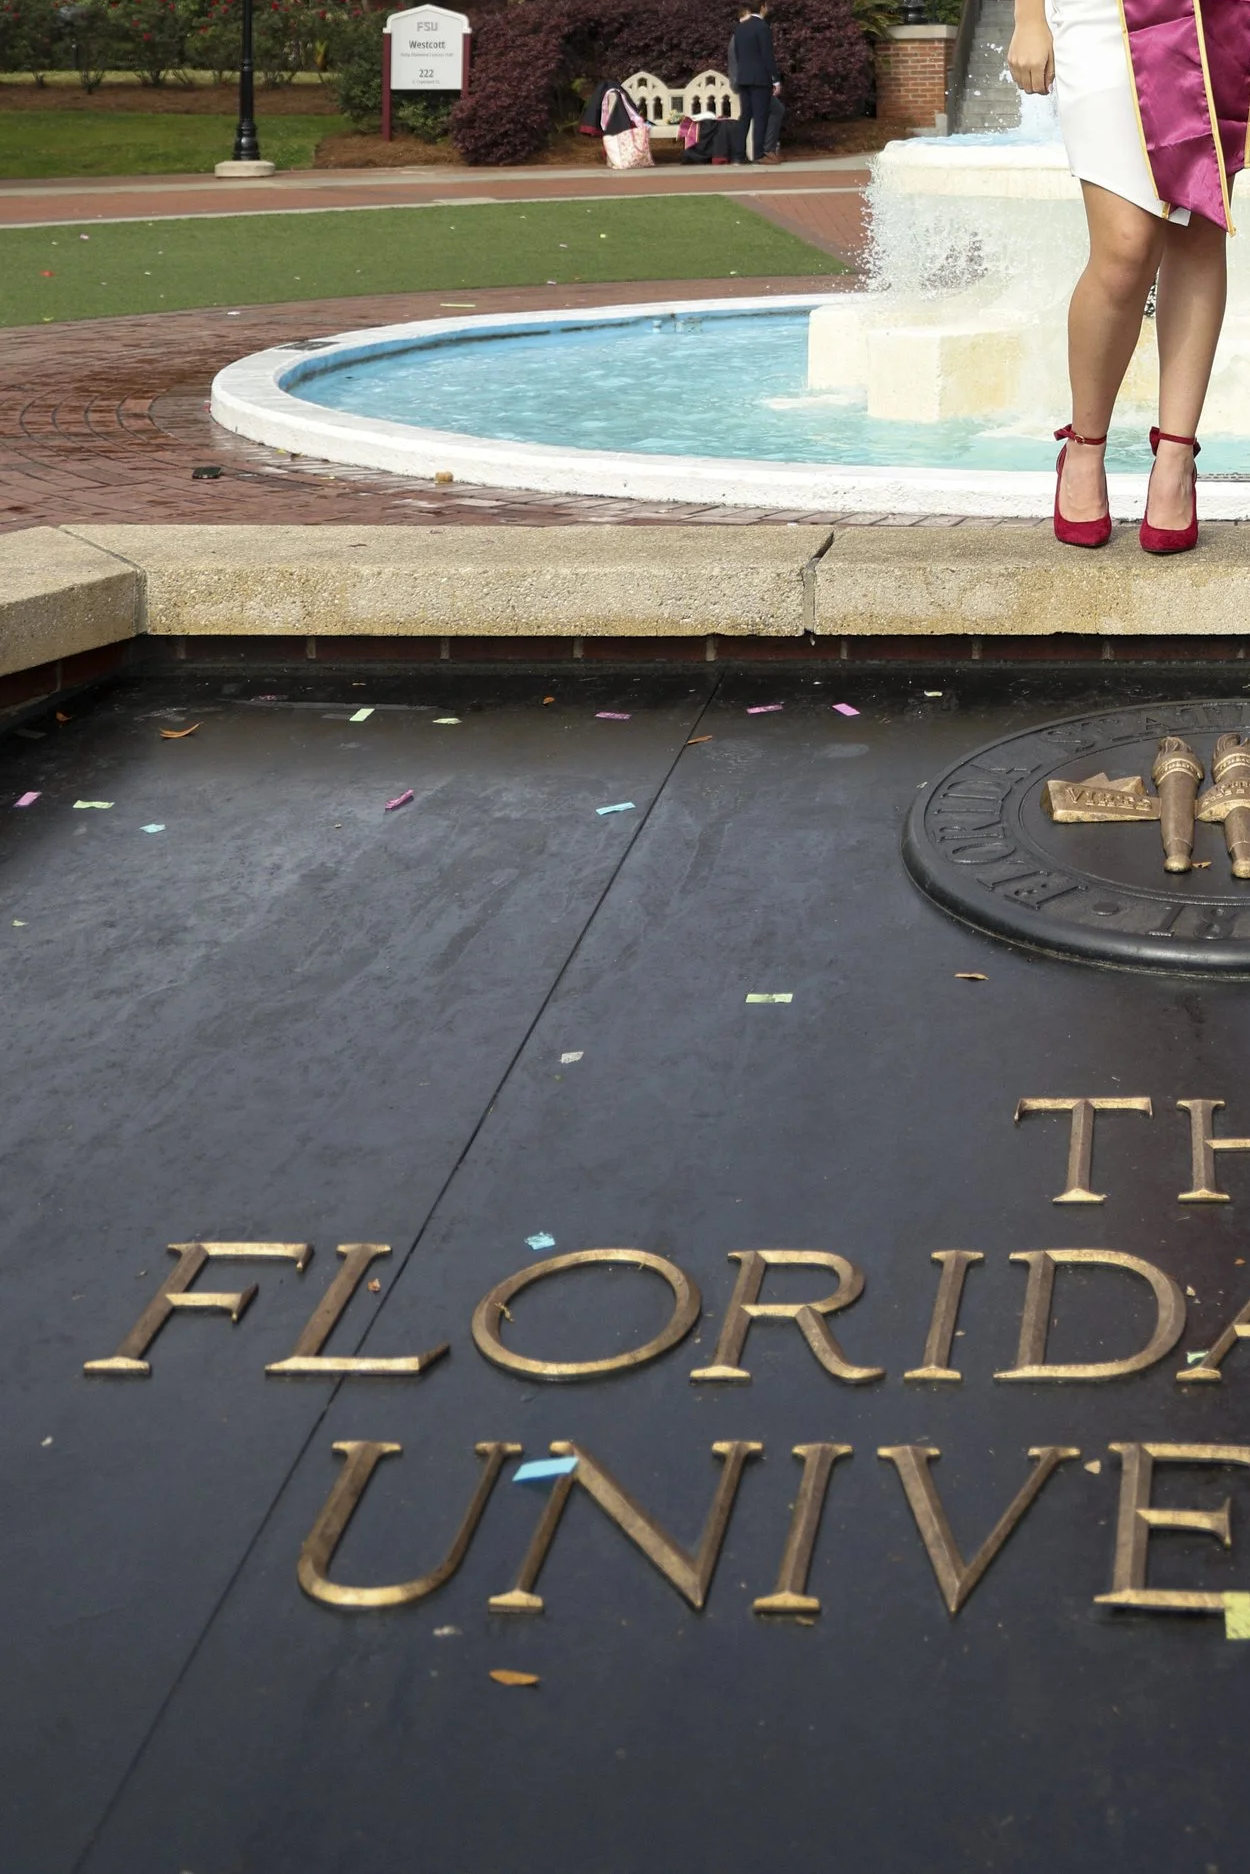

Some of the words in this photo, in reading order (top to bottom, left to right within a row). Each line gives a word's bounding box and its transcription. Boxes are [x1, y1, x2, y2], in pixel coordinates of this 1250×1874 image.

[416, 21, 438, 32] FSU
[408, 40, 445, 49] Westcott
[419, 69, 434, 78] 222
[1066, 786, 1153, 811] VIRES
[933, 762, 1088, 911] FLORIDA
